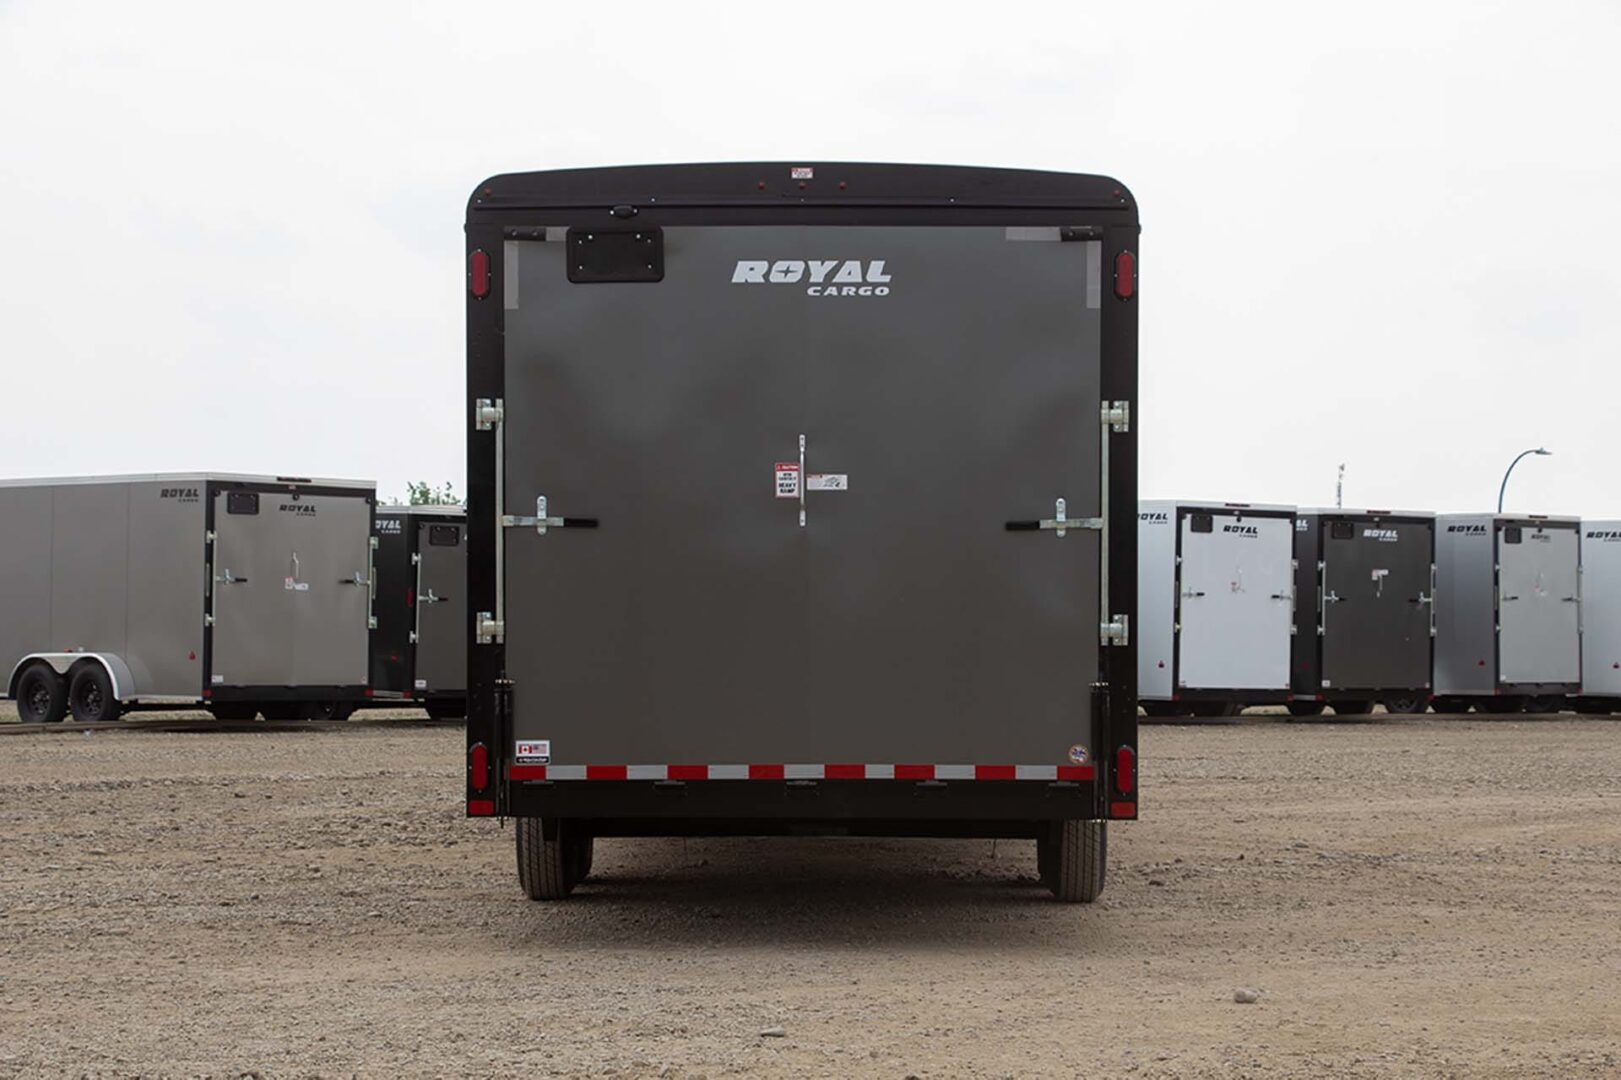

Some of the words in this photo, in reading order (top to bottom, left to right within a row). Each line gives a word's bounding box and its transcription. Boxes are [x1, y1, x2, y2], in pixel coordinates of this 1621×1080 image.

[731, 260, 892, 283] ROYAL
[807, 286, 890, 296] CARGO
[160, 488, 199, 498] ROYAL
[279, 504, 316, 513] ROYAL
[1136, 513, 1168, 521] OYAL
[375, 519, 401, 529] OYAL
[1223, 524, 1258, 534] ROYAL
[1447, 525, 1487, 533] ROYAL
[1363, 529, 1398, 538] ROYAL
